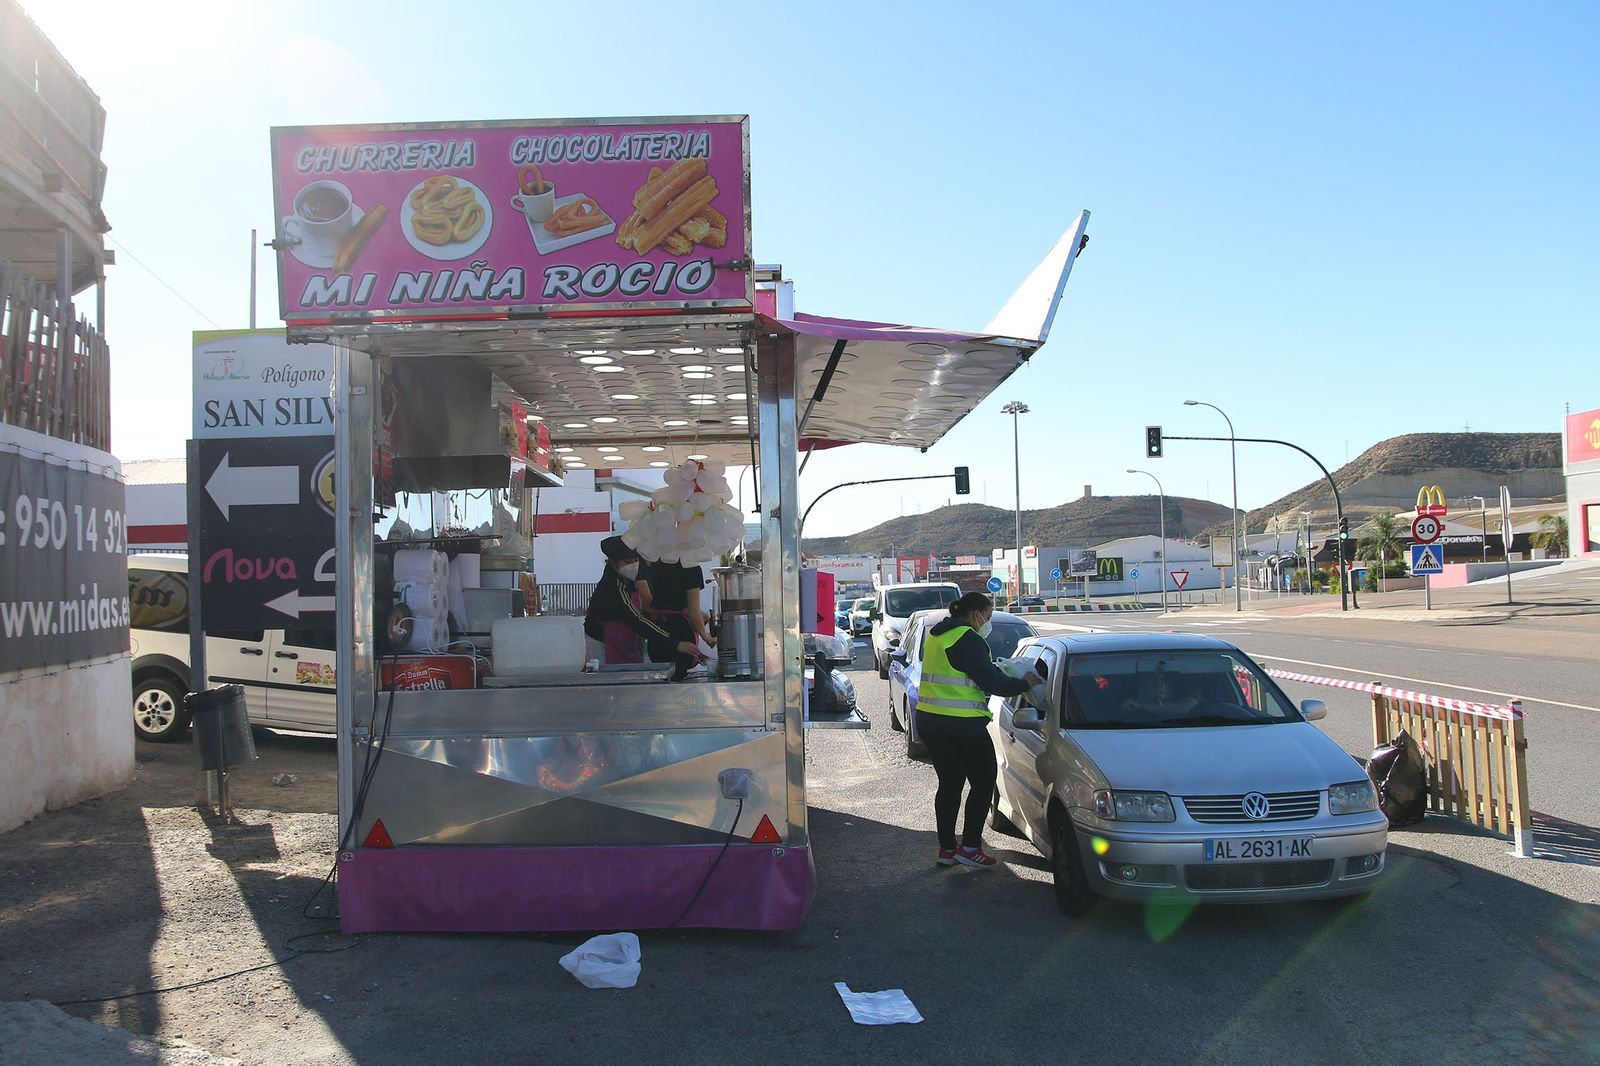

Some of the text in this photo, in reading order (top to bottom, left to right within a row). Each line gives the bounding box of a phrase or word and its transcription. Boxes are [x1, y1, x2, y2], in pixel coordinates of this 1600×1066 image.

[295, 132, 711, 173] CHURRERIA CHOCOLATERIA
[300, 260, 716, 307] MI NIÑA ROCIO
[261, 364, 326, 388] Polígono
[204, 398, 266, 428] SAN
[16, 494, 67, 550] 950
[74, 504, 98, 552] 14
[1418, 524, 1435, 534] 30
[1436, 535, 1483, 544] cDonald's
[1215, 841, 1237, 859] AL
[1241, 840, 1283, 858] 2631
[1290, 838, 1312, 857] AK
